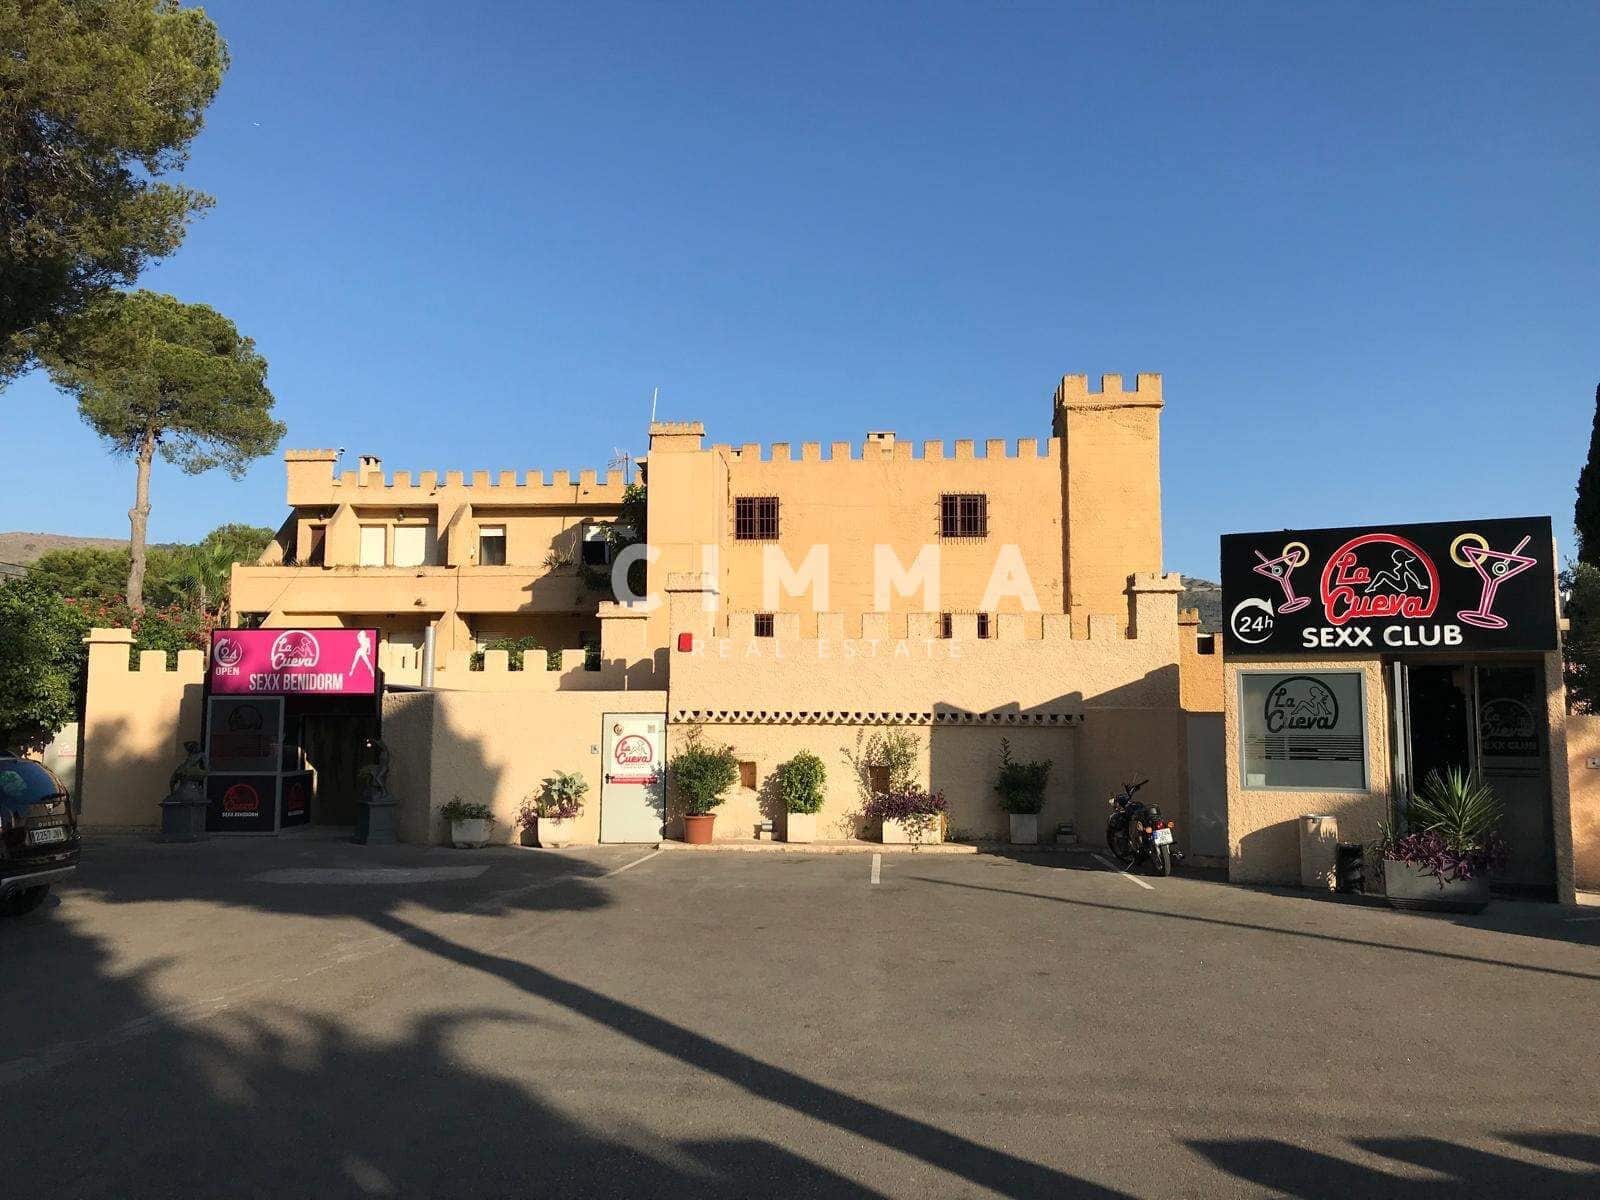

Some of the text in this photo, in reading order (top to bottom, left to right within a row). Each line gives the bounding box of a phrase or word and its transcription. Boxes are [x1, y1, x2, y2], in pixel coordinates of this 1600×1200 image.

[1336, 552, 1370, 584] La
[1324, 586, 1430, 626] Cueva
[1239, 613, 1273, 633] 24h
[277, 638, 291, 652] La
[1302, 624, 1463, 648] SEXX CLUB
[215, 667, 240, 675] OPEN
[272, 654, 316, 670] Cueva
[249, 673, 343, 691] SEXX BENIDORM
[1274, 688, 1296, 708] La
[617, 752, 648, 765] Cueva
